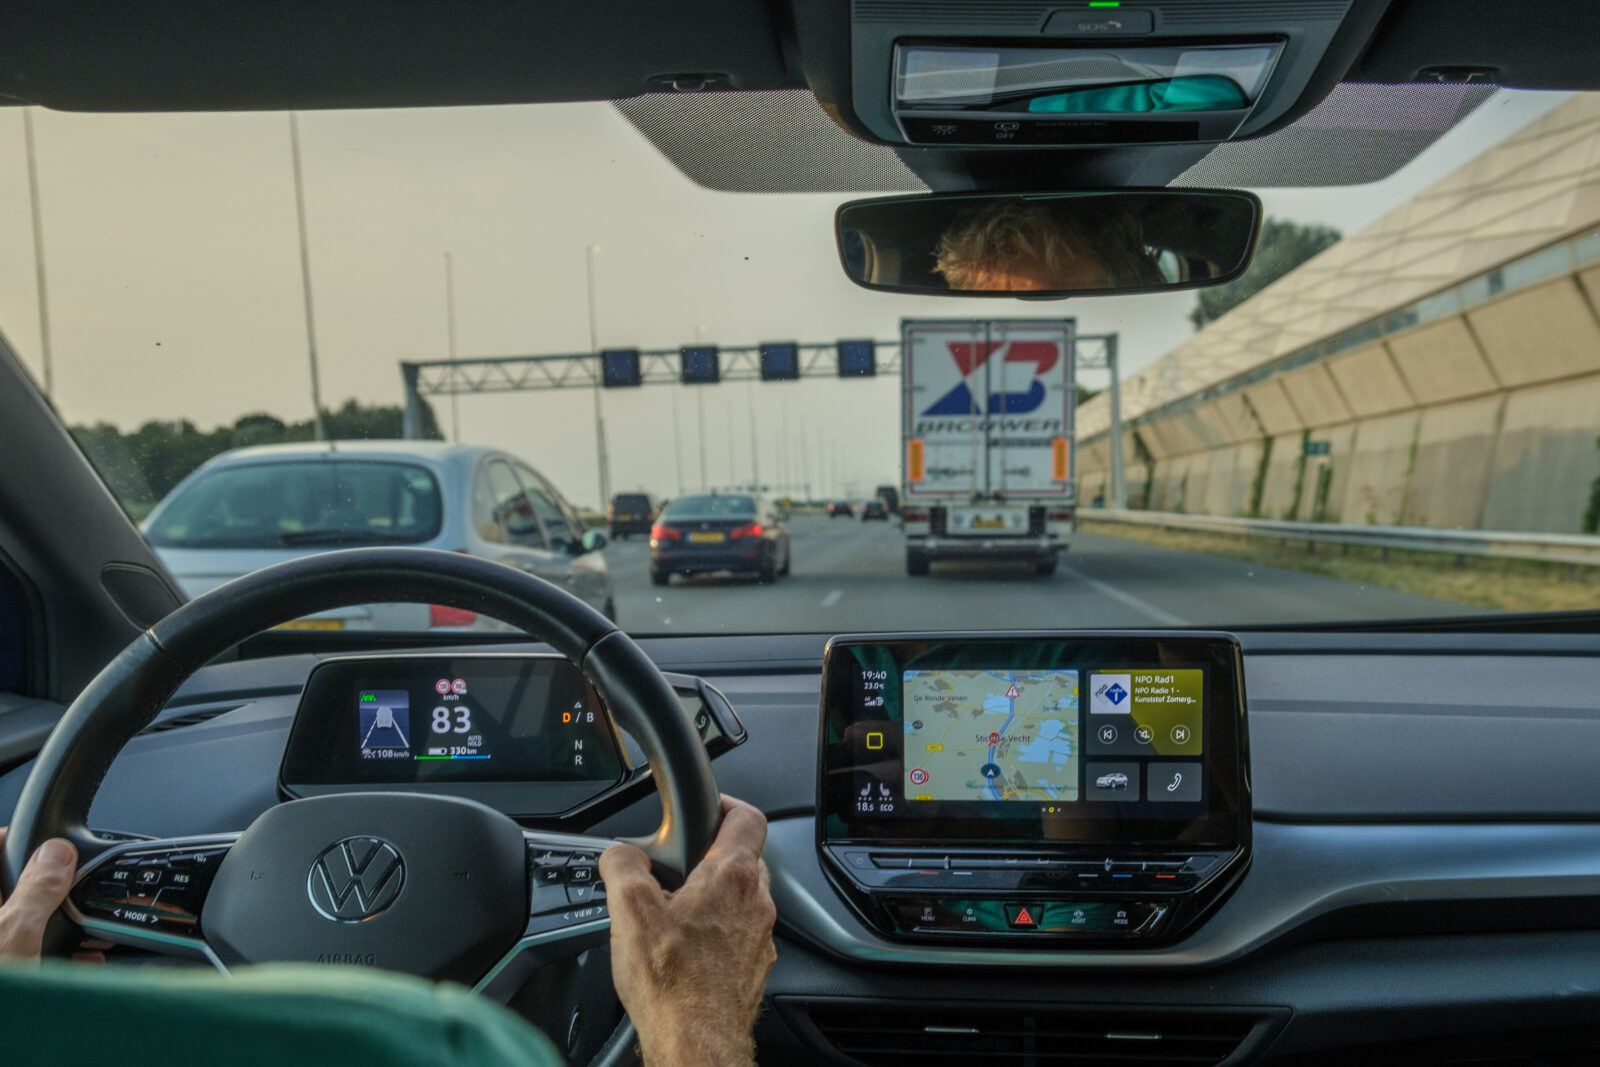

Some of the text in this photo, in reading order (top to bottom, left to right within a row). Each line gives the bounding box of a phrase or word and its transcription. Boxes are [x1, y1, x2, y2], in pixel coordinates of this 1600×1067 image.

[861, 670, 887, 680] 19:40
[1135, 675, 1153, 684] NPO
[1135, 686, 1150, 694] NPO
[1150, 686, 1169, 694] Radio
[431, 706, 471, 734] 83
[562, 711, 572, 724] D
[586, 711, 595, 723] B
[574, 739, 583, 751] N
[377, 749, 393, 758] 108
[449, 746, 466, 755] 330
[575, 754, 583, 766] R
[880, 803, 894, 811] ECO
[112, 871, 129, 880] SET
[173, 874, 190, 884] RES
[575, 869, 586, 879] OK
[124, 910, 148, 923] MODE
[574, 908, 593, 918] VIEW
[316, 953, 377, 966] AIRBAG
